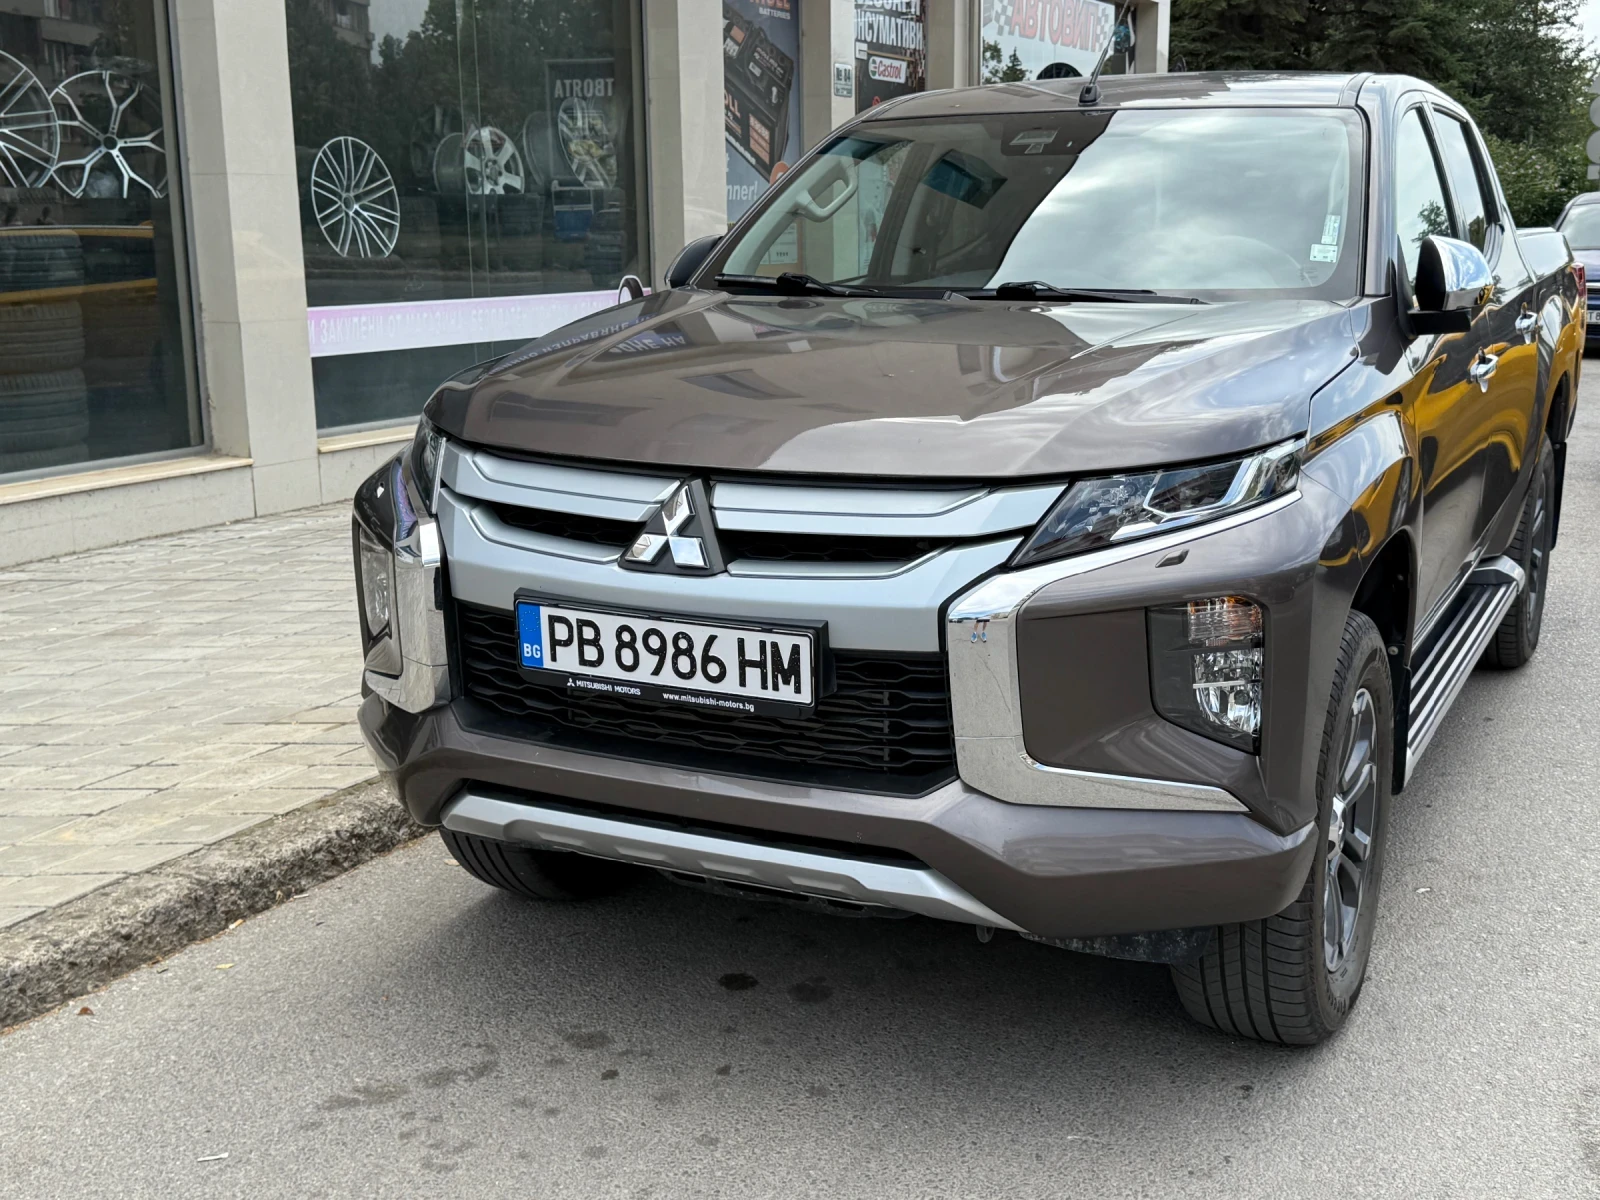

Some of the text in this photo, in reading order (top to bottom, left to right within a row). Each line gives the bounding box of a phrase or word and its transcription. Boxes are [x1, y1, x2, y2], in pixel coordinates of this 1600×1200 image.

[759, 7, 791, 20] BATTERIES
[1008, 0, 1099, 52] АВТОВИП
[877, 60, 902, 80] Castrol
[523, 642, 541, 660] BG
[547, 613, 802, 695] PB 8986 HM
[576, 680, 641, 696] MITSUBISHI MOTORS
[663, 691, 755, 712] www.mitsubishi-motors.bg
